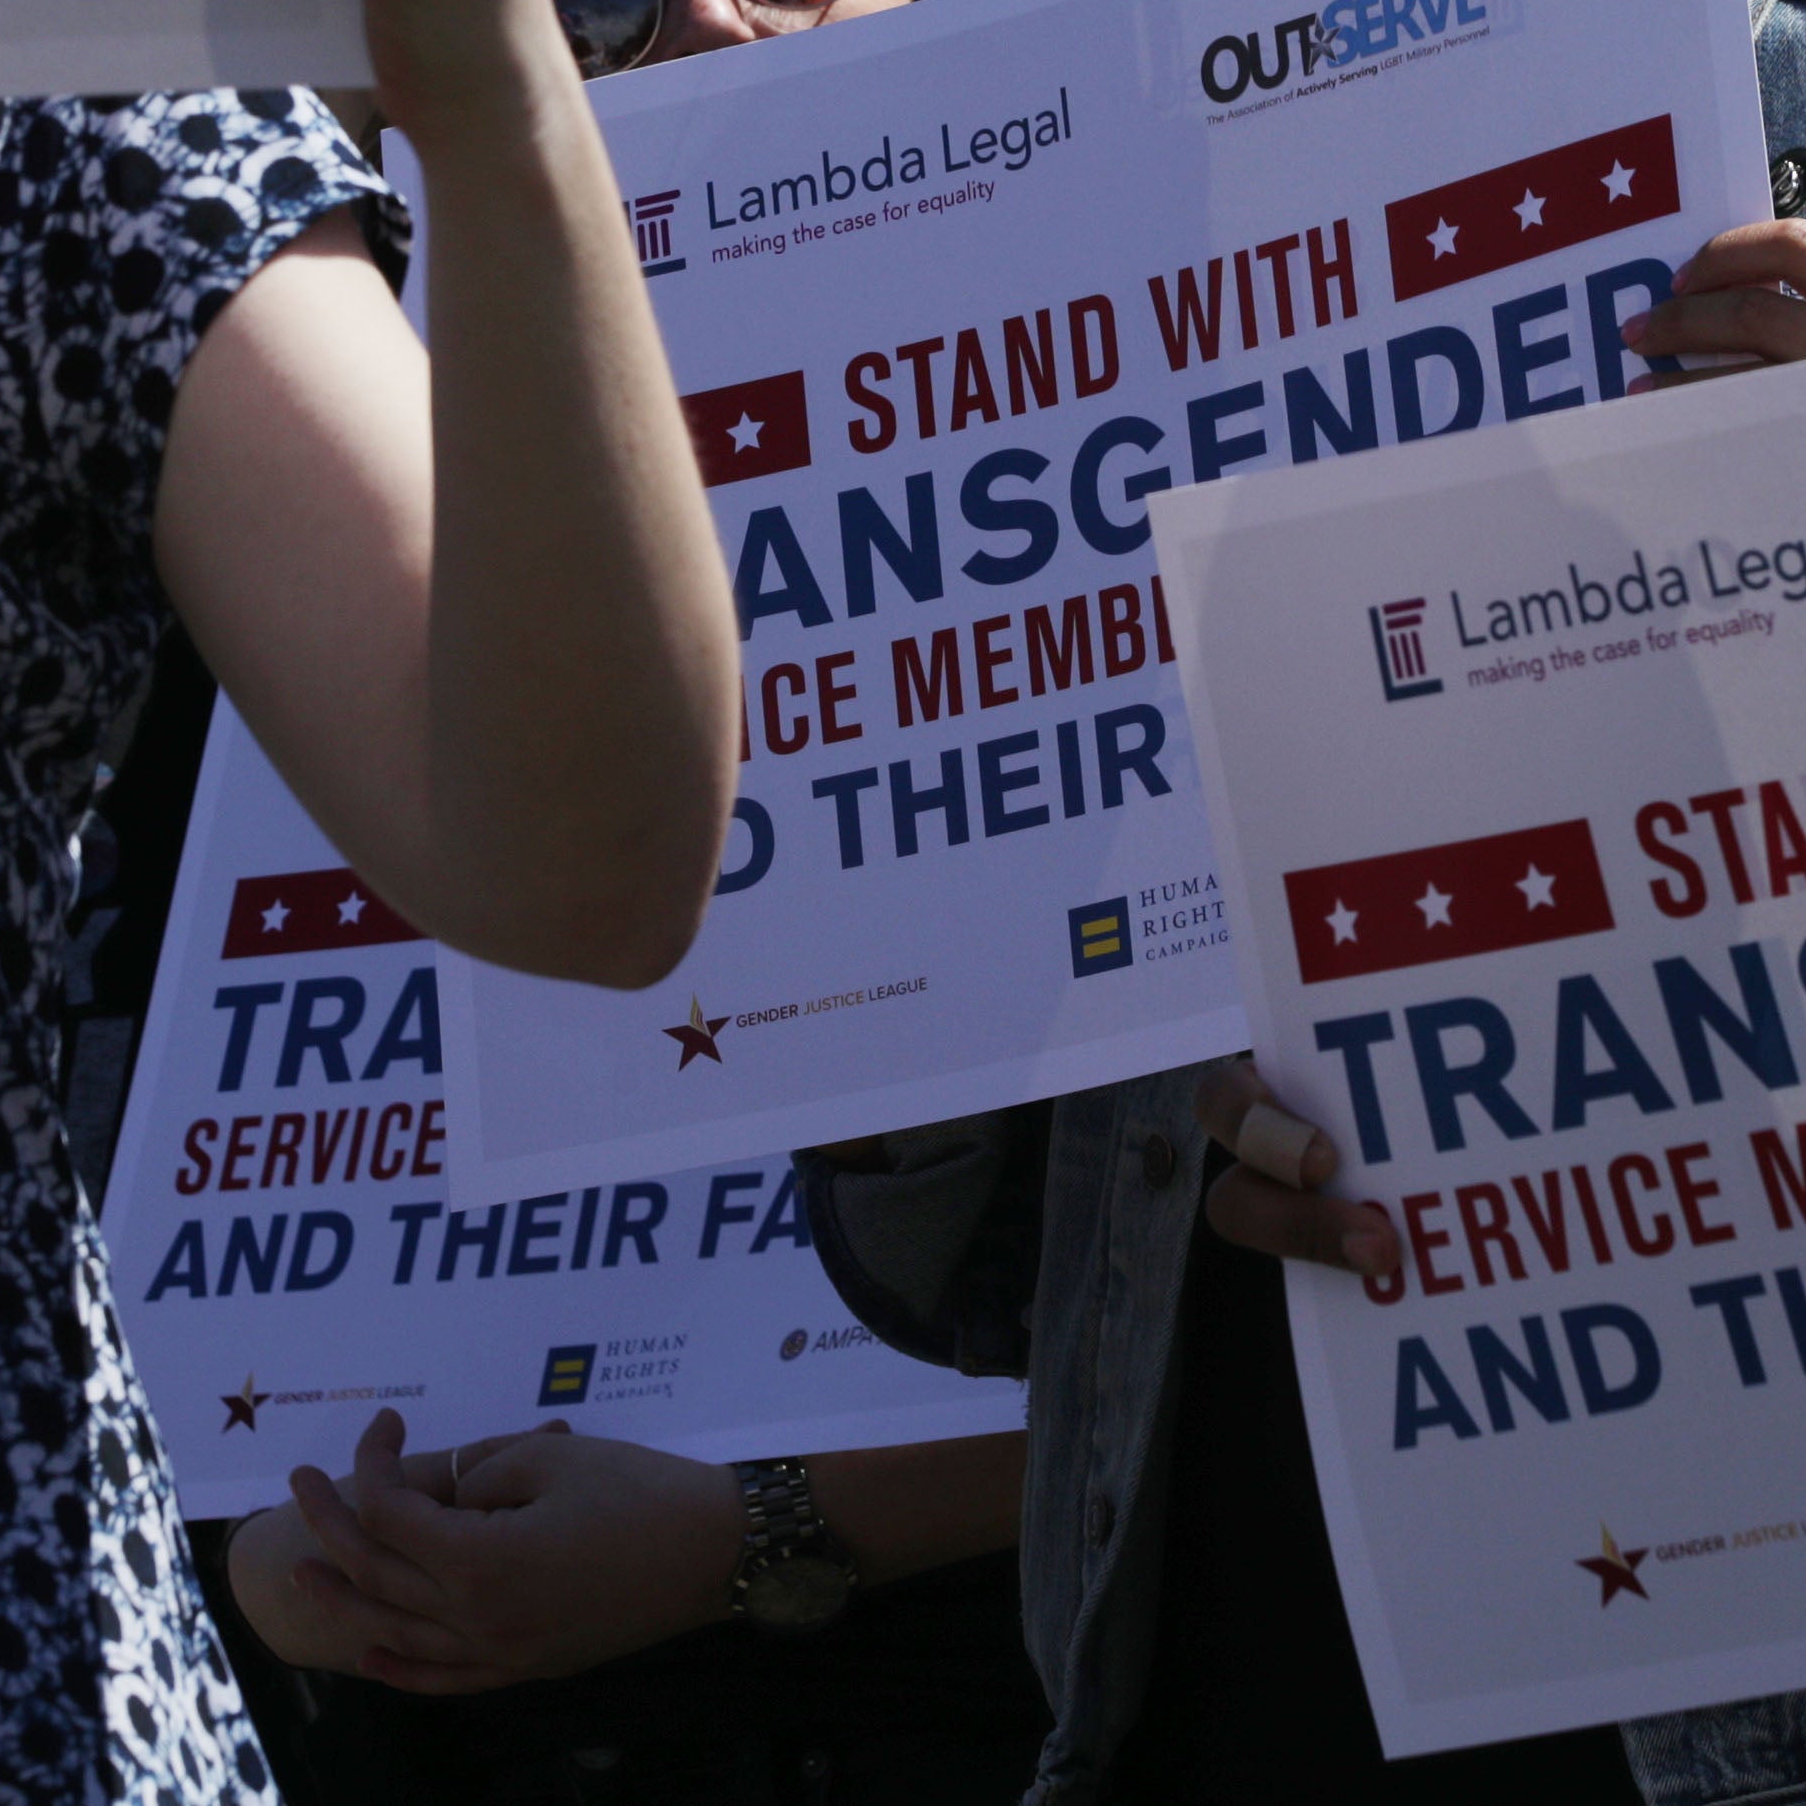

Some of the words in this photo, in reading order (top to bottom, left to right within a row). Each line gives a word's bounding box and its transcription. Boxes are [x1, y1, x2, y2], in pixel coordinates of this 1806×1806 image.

[1296, 77, 1338, 99] Actively
[1338, 64, 1379, 85] Serving
[706, 135, 927, 230] Lambda
[941, 86, 1073, 172] Legal
[712, 232, 787, 265] making
[792, 222, 827, 246] the
[832, 212, 878, 237] case
[882, 200, 912, 224] for
[917, 179, 996, 216] equality
[842, 292, 1120, 455] STAND
[1147, 217, 1360, 373] WITH
[737, 256, 1684, 644] ANSGENDER
[1450, 550, 1692, 648] Lambda
[1467, 654, 1548, 688] making
[1550, 646, 1587, 672] the
[1592, 638, 1641, 664] case
[1646, 626, 1679, 652] for
[1685, 607, 1775, 645] equality
[811, 702, 1174, 872] THEIR
[1139, 873, 1219, 908] HUMA
[1142, 900, 1226, 938] RIGHT
[1145, 929, 1230, 962] CAMPAIG
[735, 1003, 799, 1029] GENDER
[803, 990, 865, 1016] JUSTICE
[868, 977, 929, 1002] LEAGUE
[174, 1099, 447, 1196] SERVICE
[143, 1209, 355, 1303] AND
[389, 1180, 669, 1286] THEIR
[598, 1357, 681, 1382] RIGHTS
[606, 1333, 688, 1358] HUMAN
[1393, 1302, 1663, 1453] AND
[1655, 1534, 1726, 1563] GENDER
[1731, 1521, 1799, 1550] JUSTICE
